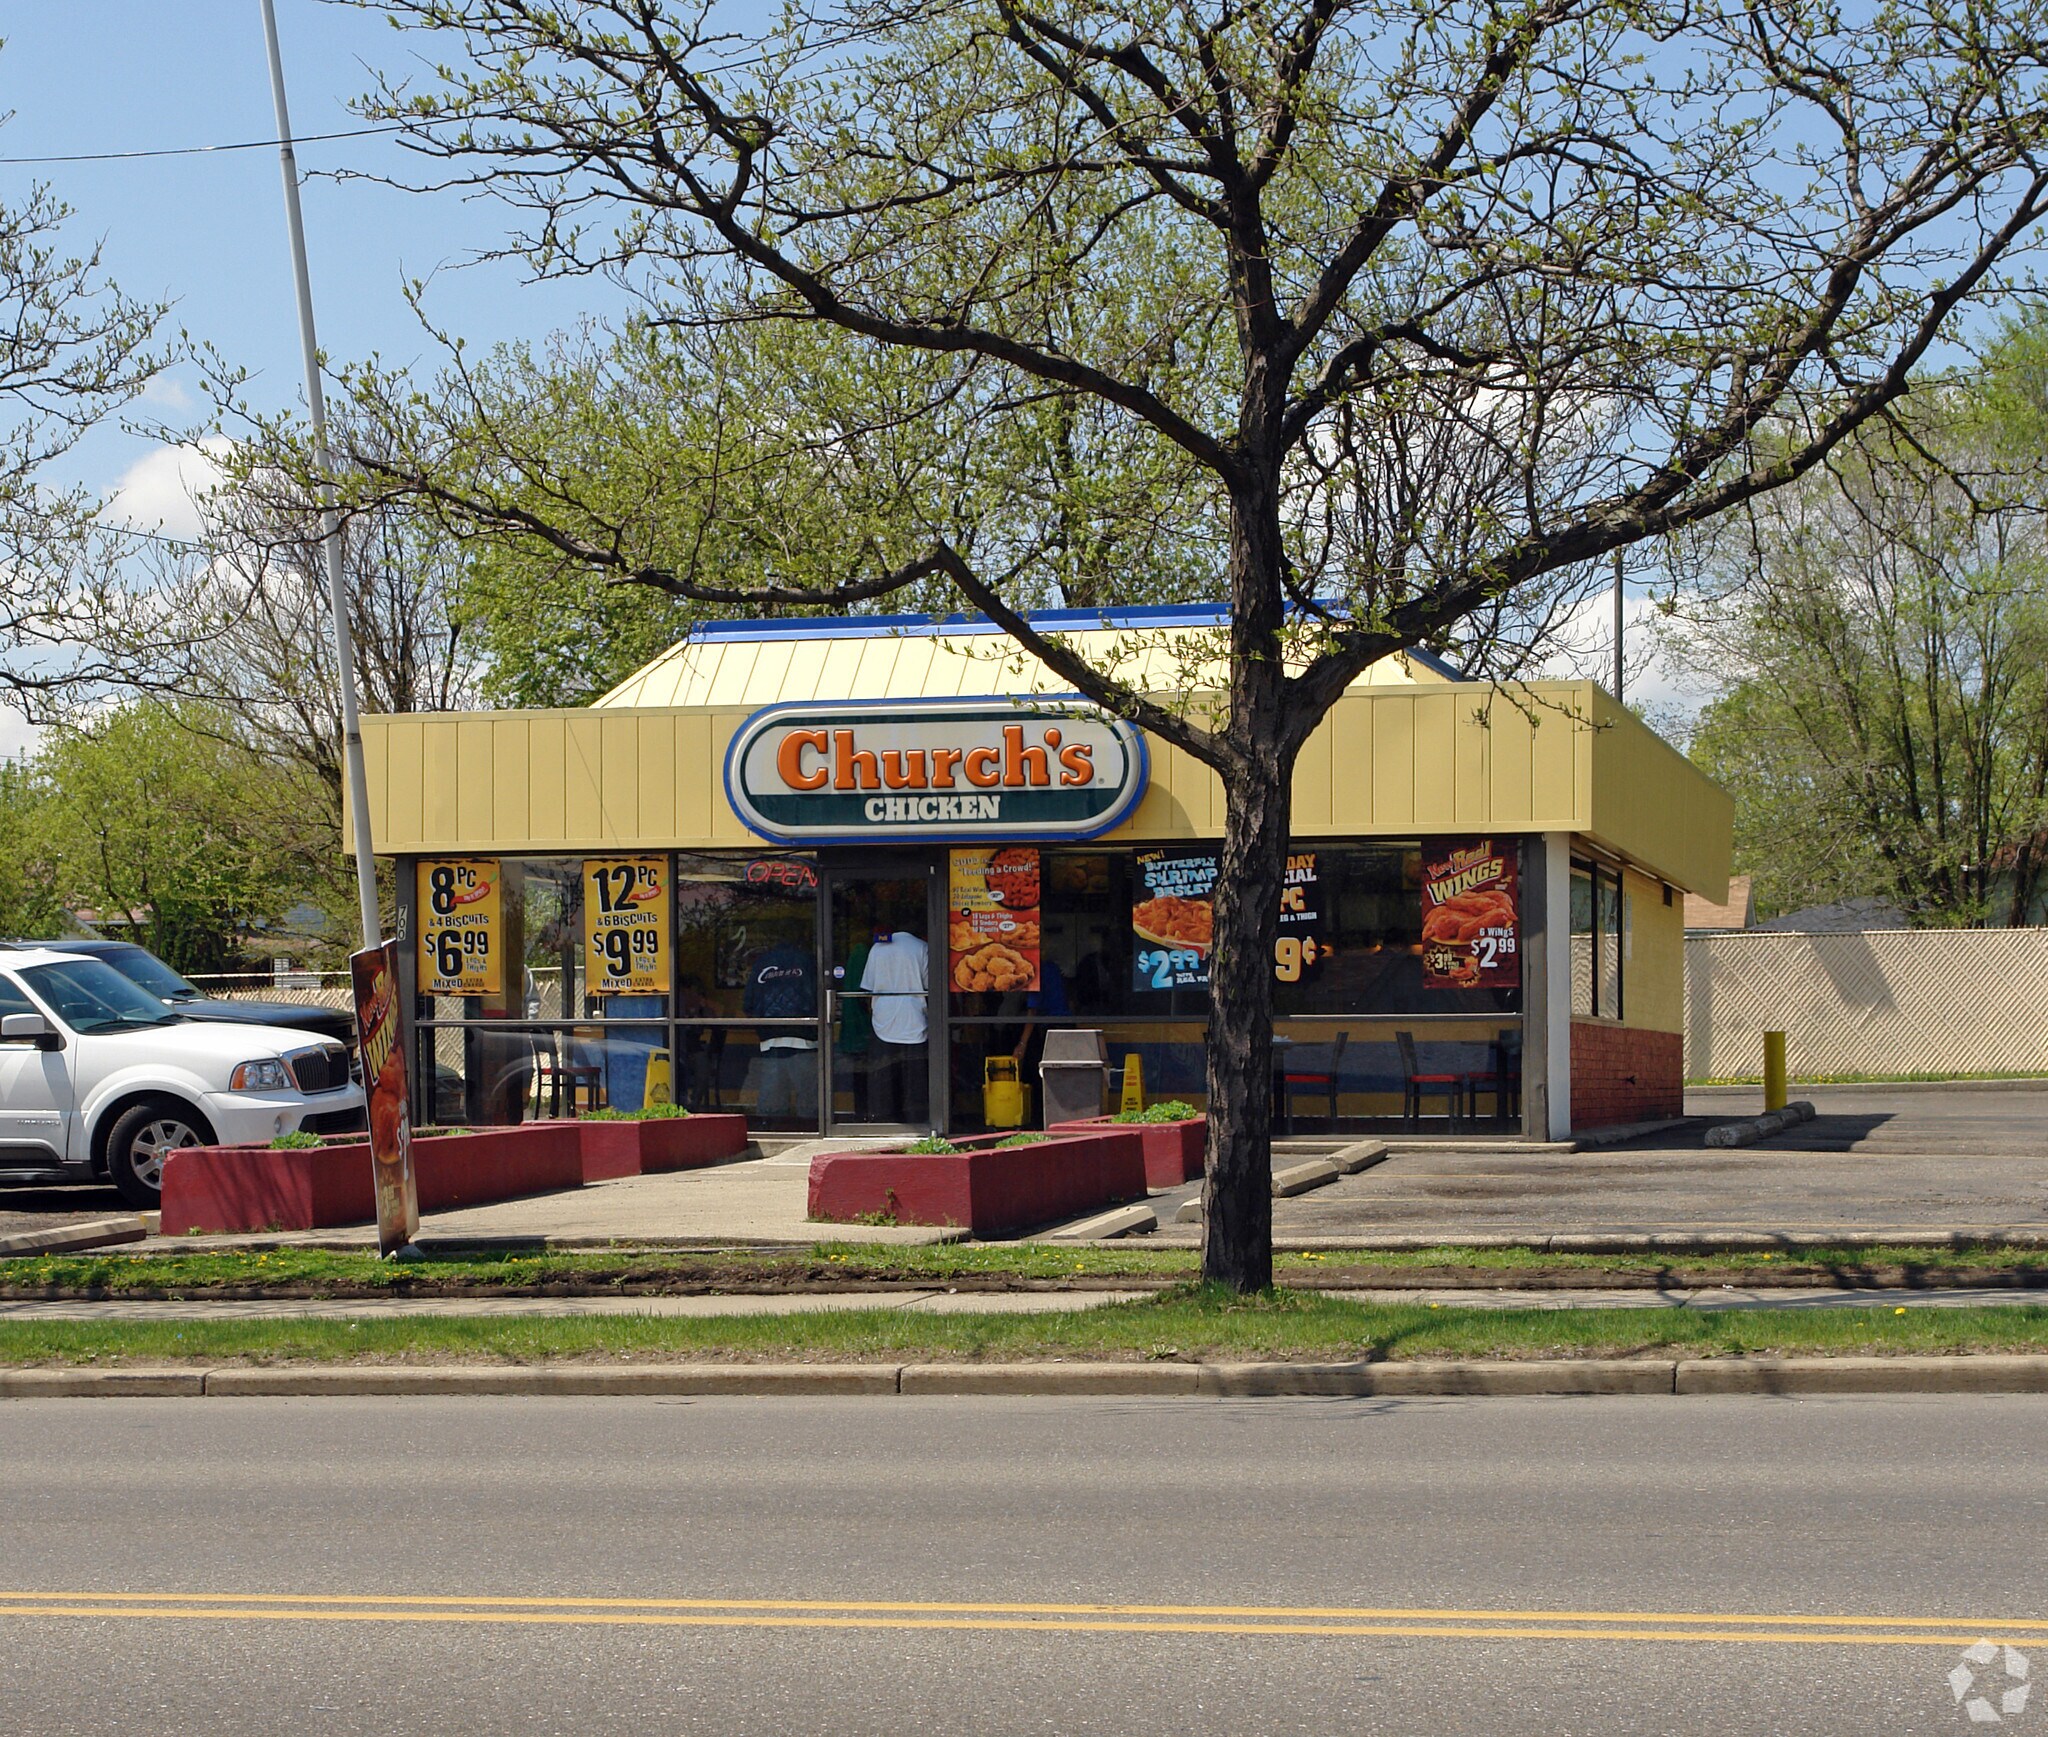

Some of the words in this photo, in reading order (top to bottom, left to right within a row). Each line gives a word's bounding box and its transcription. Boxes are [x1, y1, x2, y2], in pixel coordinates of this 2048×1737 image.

[777, 725, 1094, 790] Church's
[864, 795, 1001, 822] CHICKEN
[1136, 849, 1165, 865] NEW!
[1144, 856, 1217, 872] BUTTERFLY
[1286, 854, 1316, 871] DAY
[1450, 840, 1491, 874] Real
[747, 861, 818, 887] OPEN
[1427, 858, 1504, 905] WINGS
[1153, 882, 1213, 898] BASKET
[429, 918, 436, 928] &
[436, 916, 444, 928] 4
[597, 917, 603, 926] &
[604, 915, 612, 927] 6
[1279, 914, 1289, 922] EG
[1296, 911, 1318, 921] THIGH
[1275, 936, 1317, 982] 9¢
